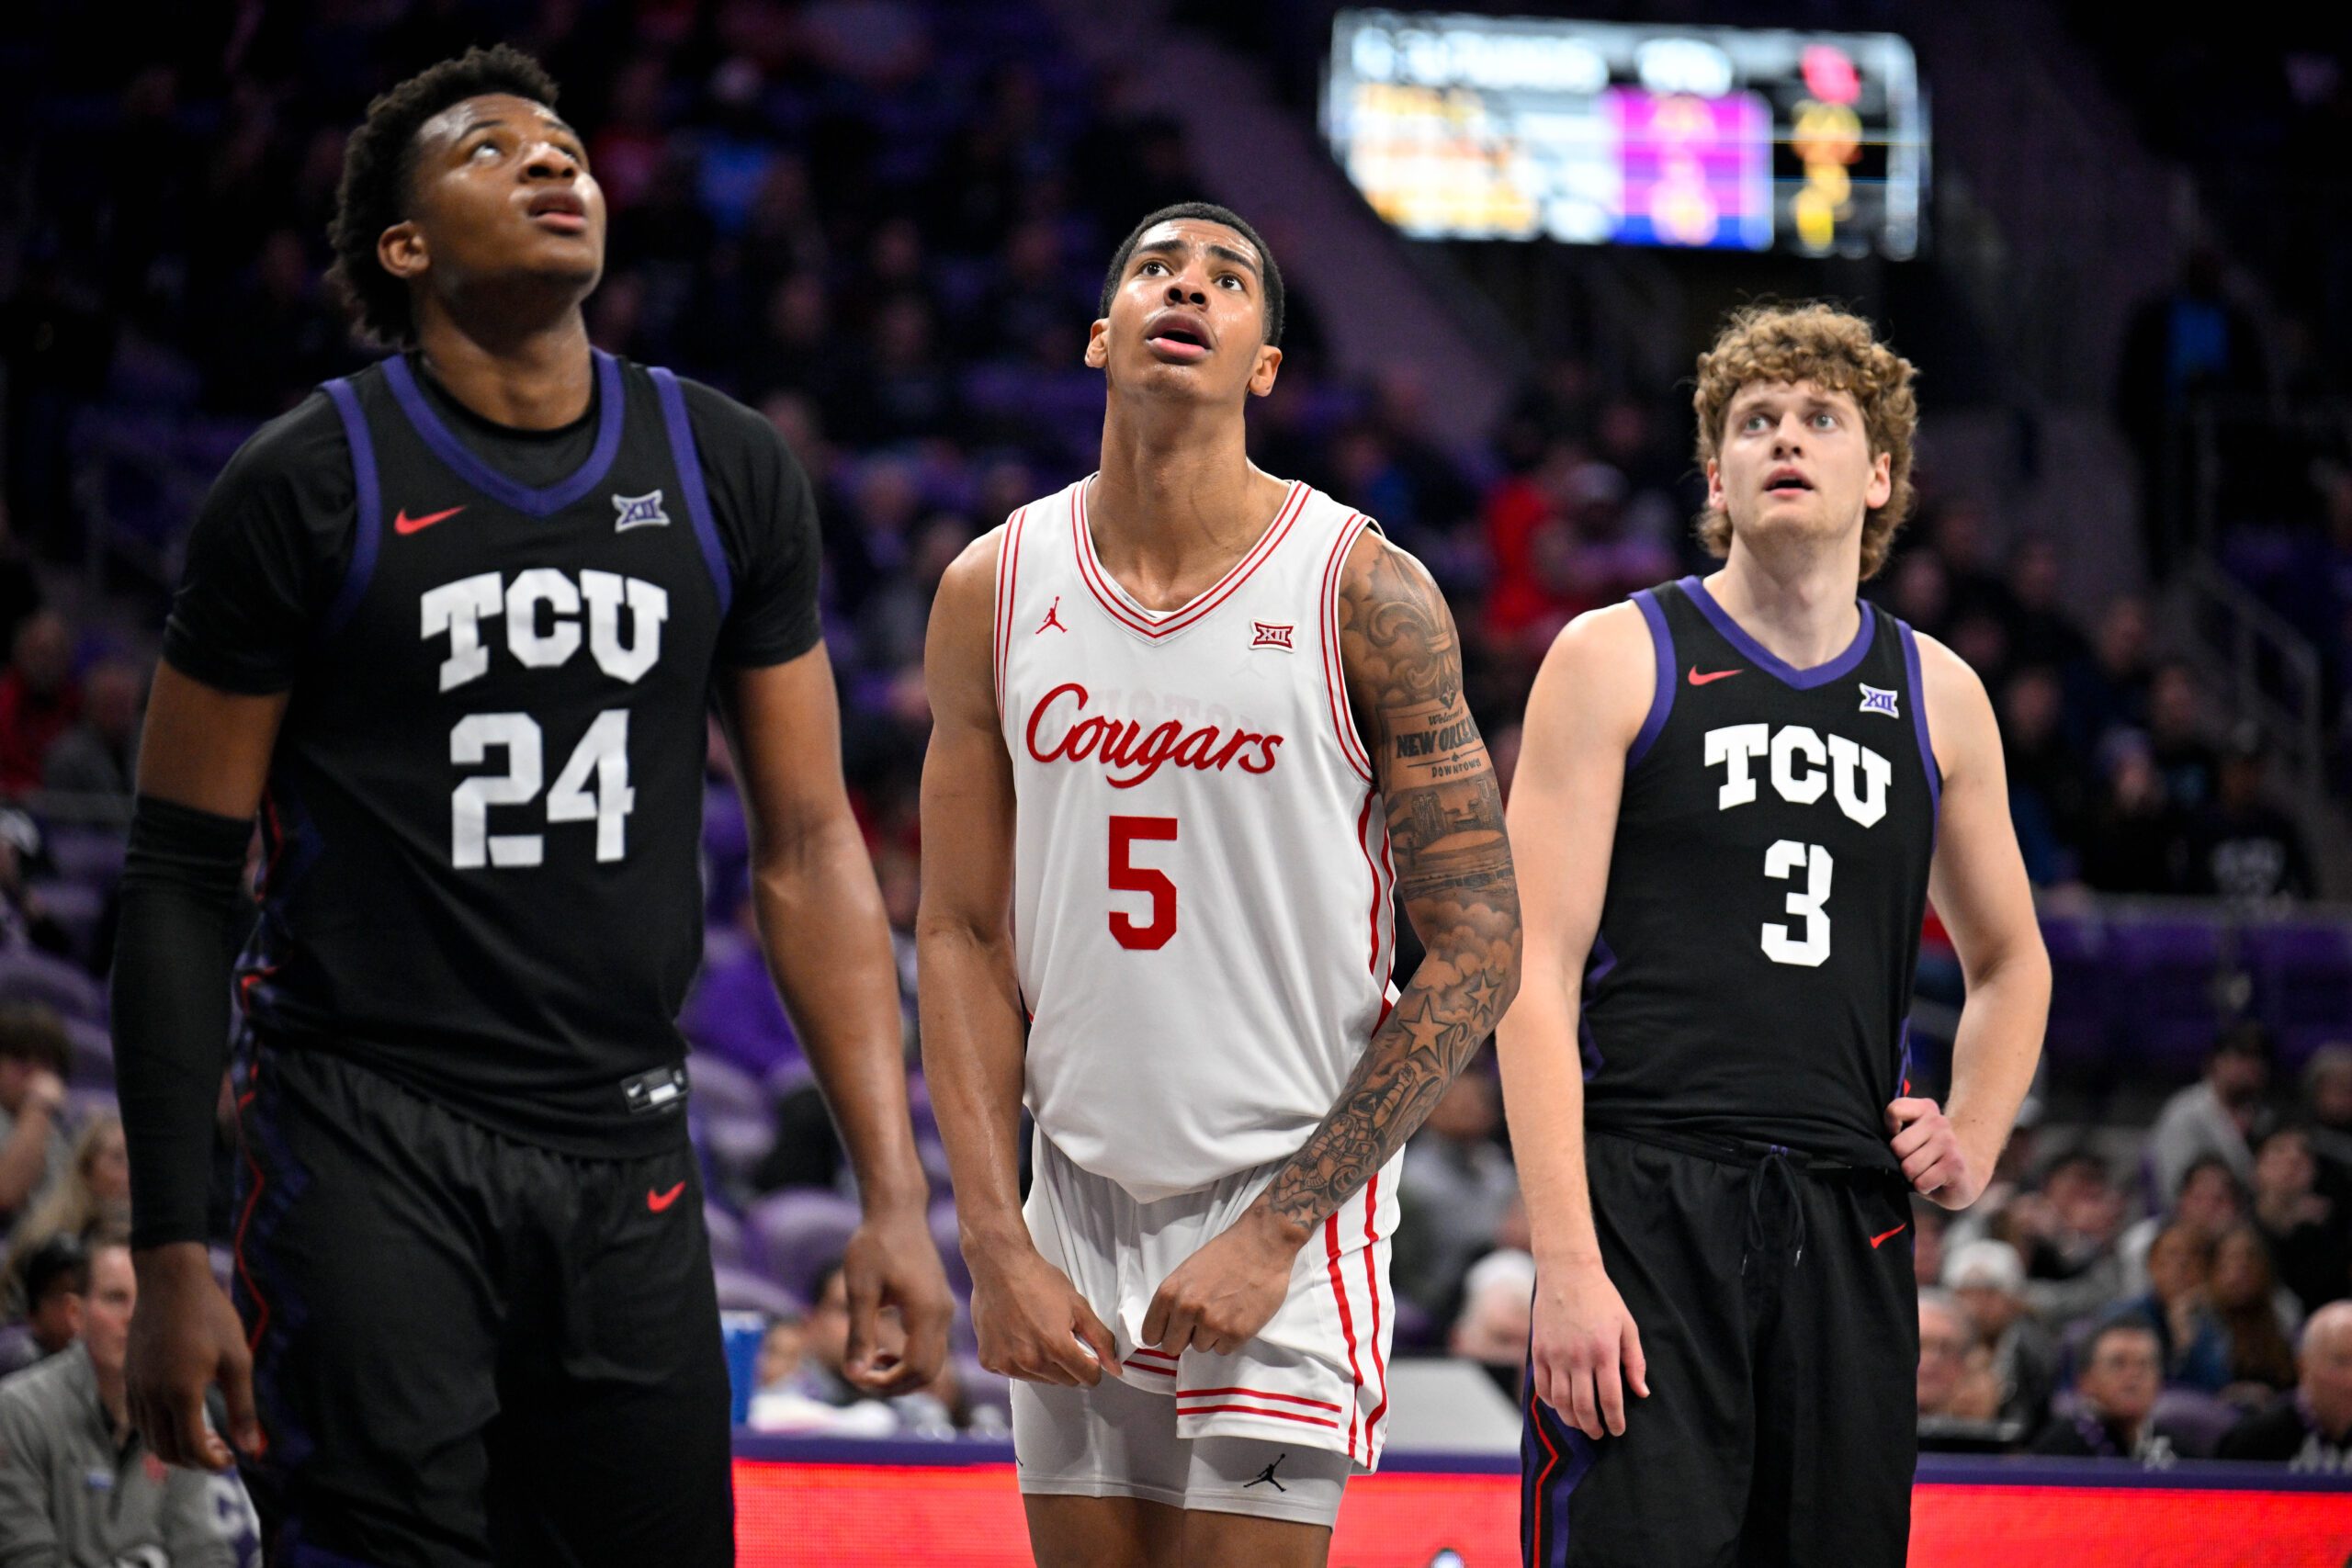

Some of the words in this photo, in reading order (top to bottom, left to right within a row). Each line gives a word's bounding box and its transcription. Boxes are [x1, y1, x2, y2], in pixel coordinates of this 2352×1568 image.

[422, 568, 669, 694] TCU
[450, 708, 636, 869] 24
[1026, 682, 1284, 789] Cougars
[1396, 729, 1438, 760] NEW
[1431, 757, 1482, 779] DOWNTOWN
[1704, 723, 1892, 829] TCU
[1108, 815, 1178, 951] 5
[1760, 839, 1834, 967] 3
